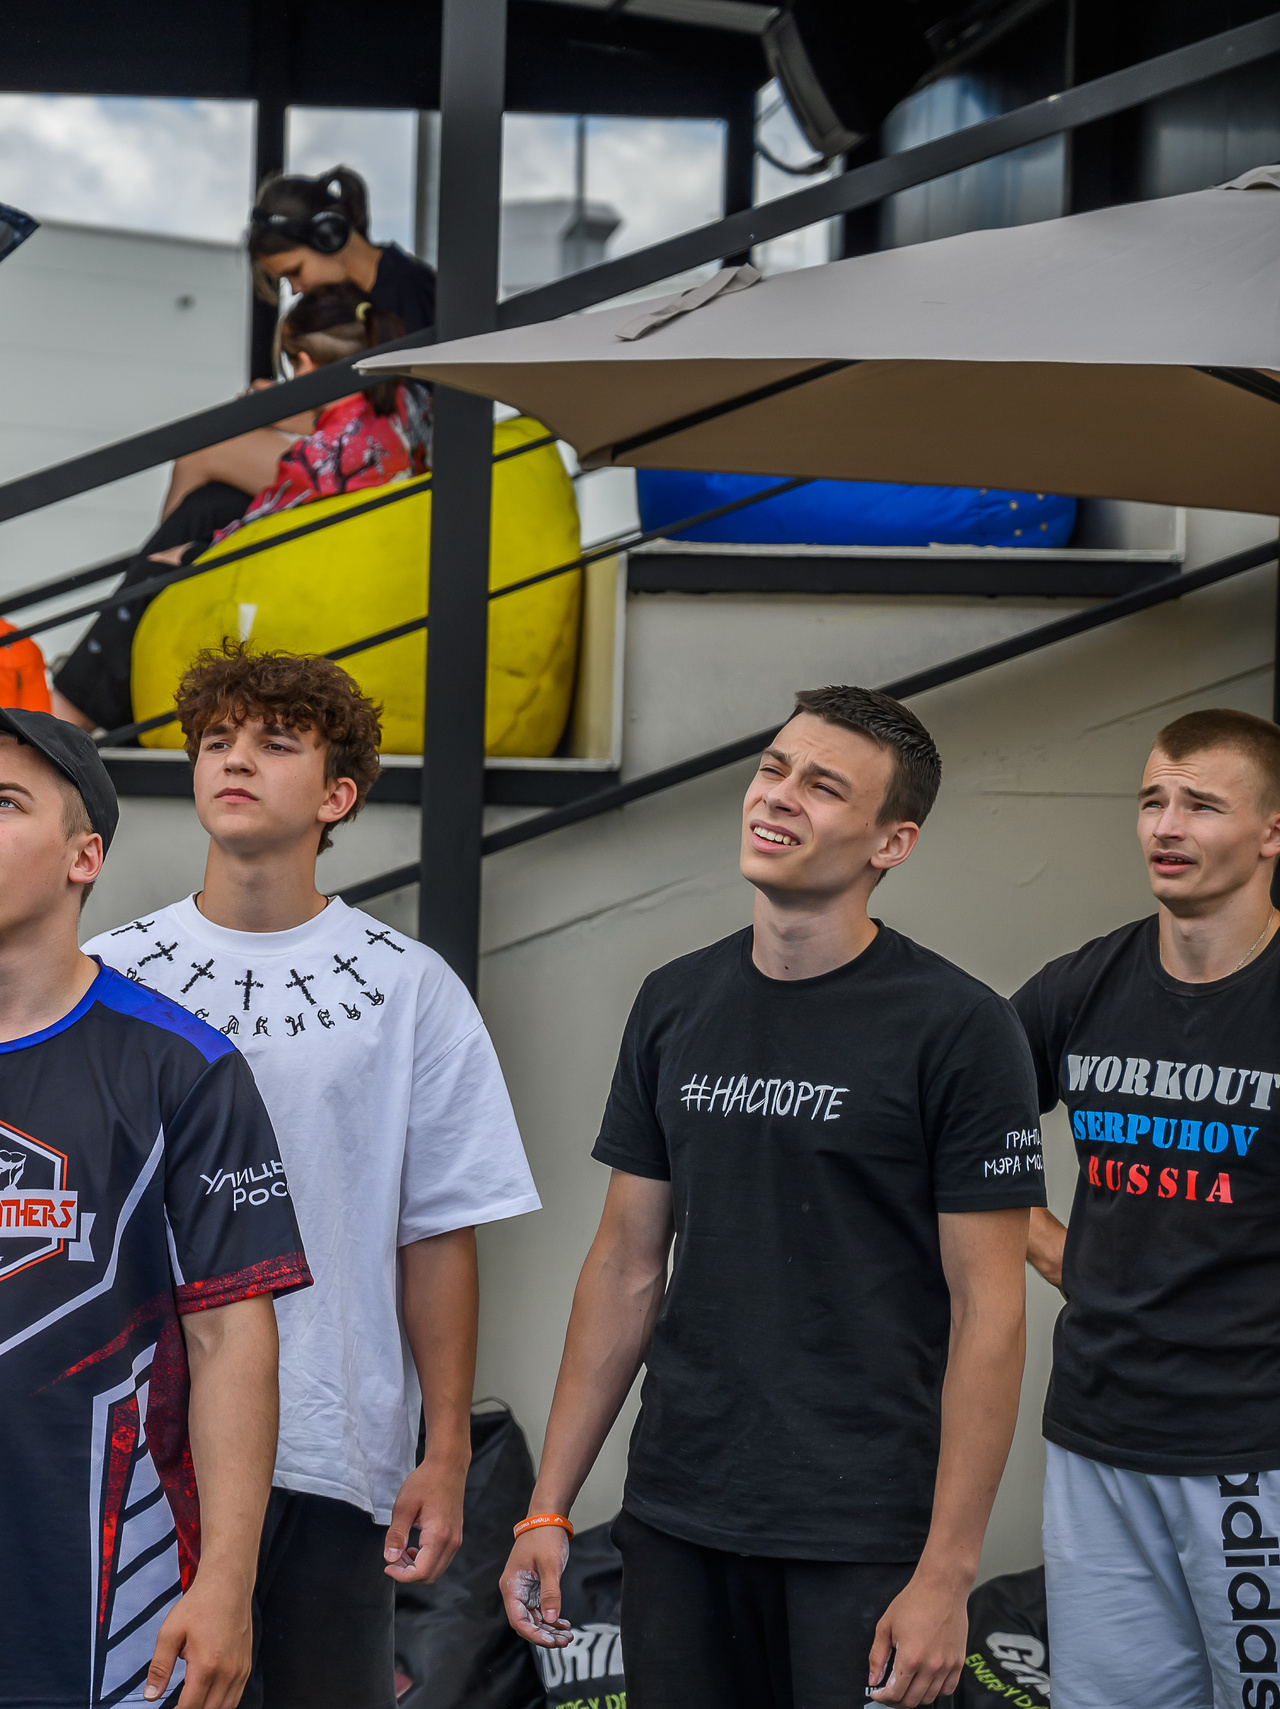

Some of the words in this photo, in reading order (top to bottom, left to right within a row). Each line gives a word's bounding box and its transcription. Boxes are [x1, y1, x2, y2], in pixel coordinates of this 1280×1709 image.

[680, 1073, 851, 1122] #НАСПОРТЕ
[1067, 1054, 1280, 1110] WORKOUT
[1073, 1110, 1259, 1157] SERPUHOV
[984, 1155, 1022, 1178] МЭРА
[1088, 1155, 1234, 1204] RUSSIA
[233, 1181, 288, 1212] Рос
